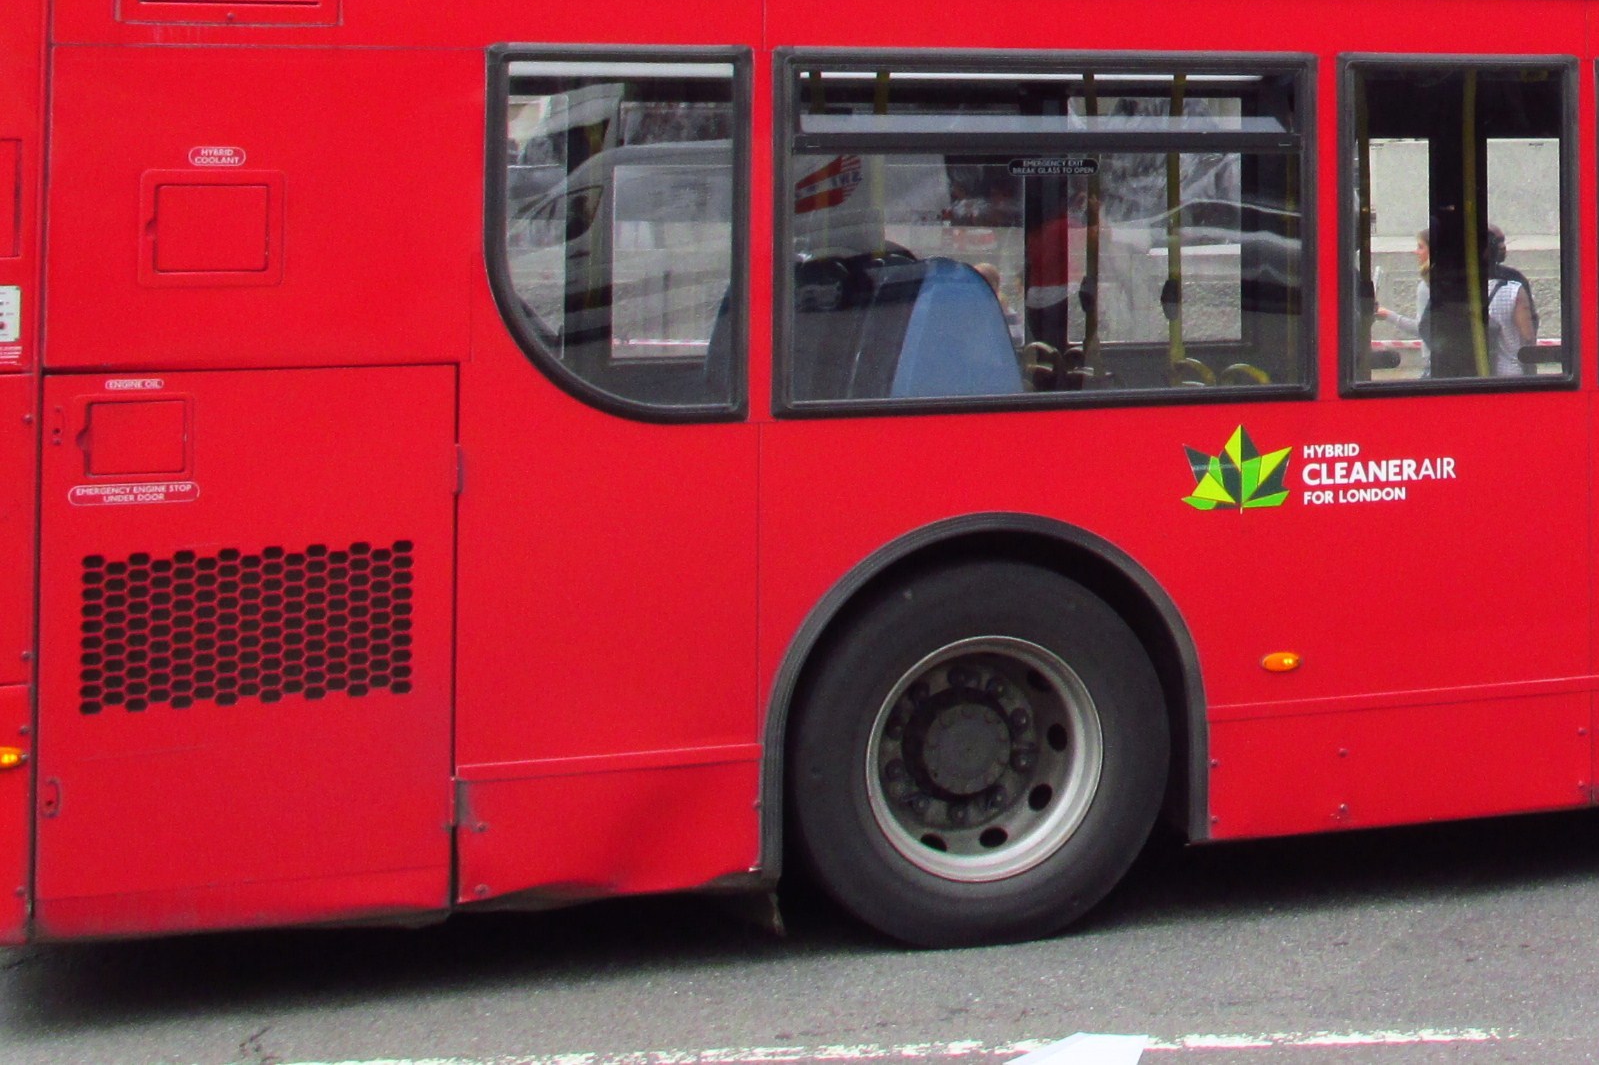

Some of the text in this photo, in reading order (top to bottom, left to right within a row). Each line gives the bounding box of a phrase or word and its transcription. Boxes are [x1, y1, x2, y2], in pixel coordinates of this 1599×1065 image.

[200, 148, 234, 156] HYBRID
[194, 156, 240, 165] COOLANT
[1303, 443, 1361, 459] HYBRID
[1301, 457, 1457, 486] CLEANERAIR
[75, 484, 192, 497] EMERGENCY ENGINE STOP
[1303, 486, 1407, 506] FOR LONDON
[103, 493, 165, 503] UNDER DOOR
